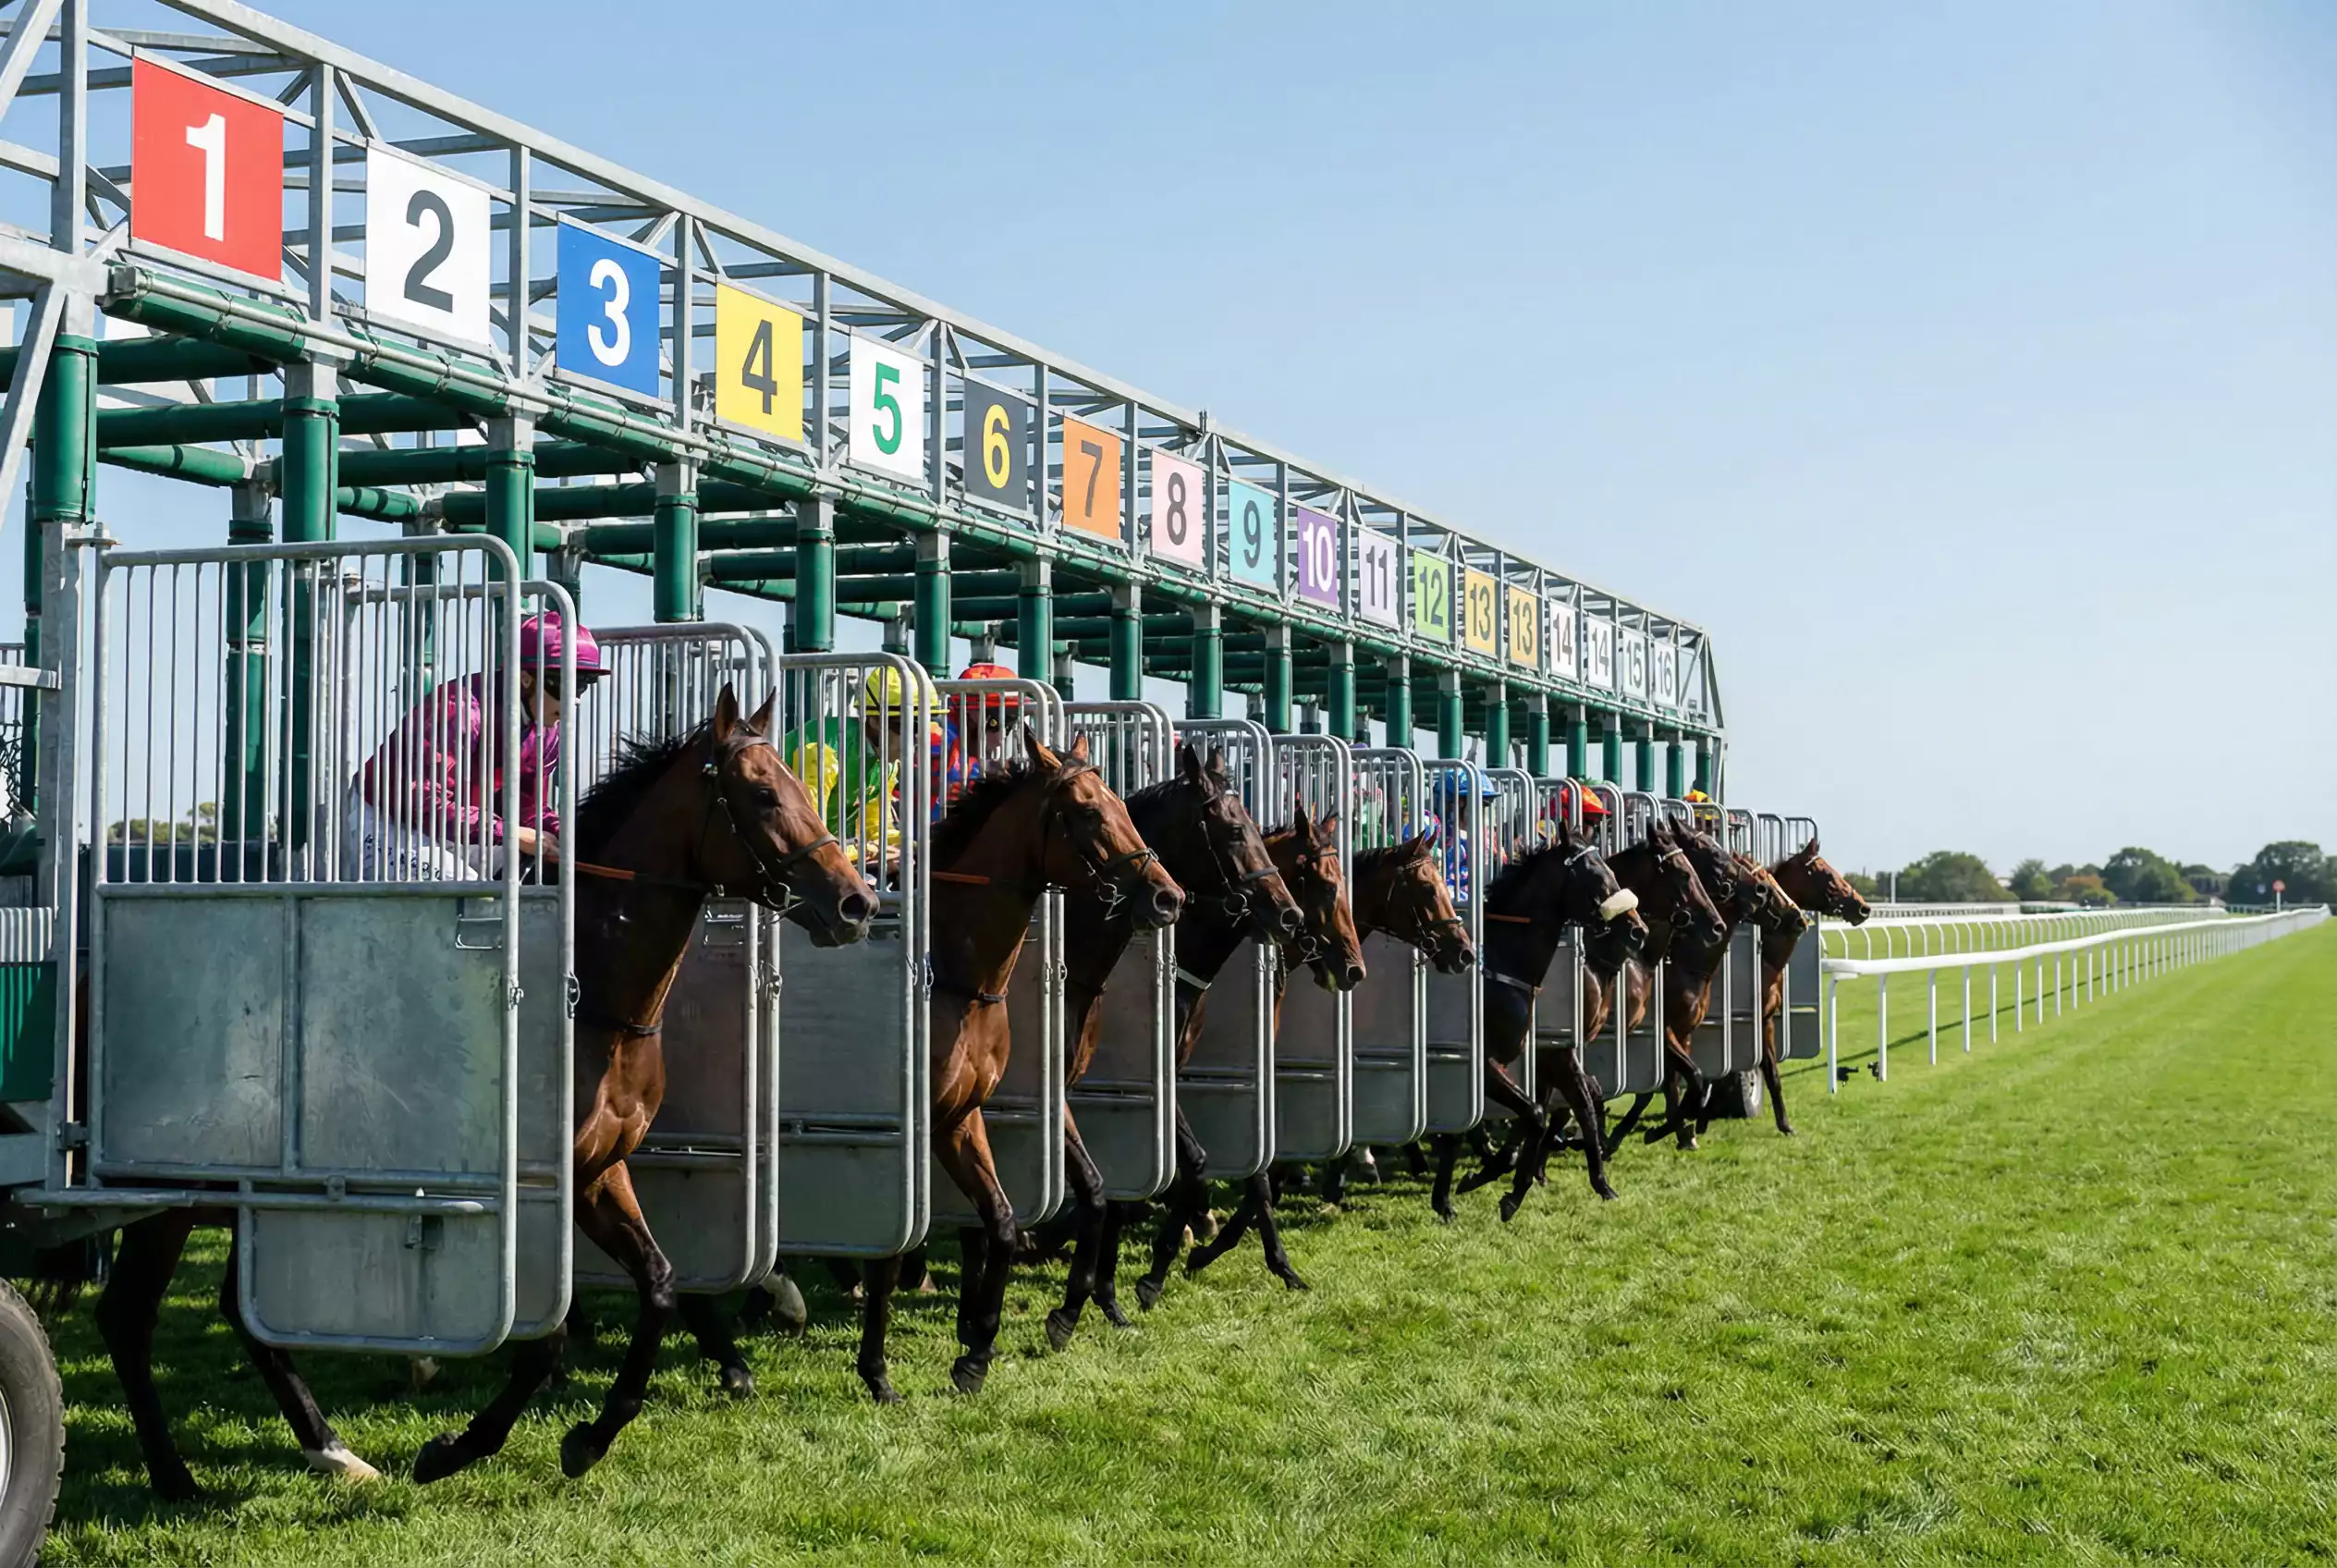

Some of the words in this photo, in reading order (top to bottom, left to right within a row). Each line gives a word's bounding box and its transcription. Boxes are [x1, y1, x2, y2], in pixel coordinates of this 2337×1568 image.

[186, 113, 225, 242] 1
[404, 190, 455, 312] 2
[586, 259, 630, 367] 3
[742, 319, 777, 415] 4
[873, 361, 902, 455] 5
[983, 404, 1010, 488] 6
[1081, 440, 1103, 517] 7
[1167, 472, 1187, 545] 8
[1243, 500, 1261, 569] 9
[1303, 521, 1334, 592] 10
[1365, 545, 1388, 610] 11
[1419, 566, 1444, 627] 12
[1470, 583, 1491, 641] 13
[1513, 598, 1533, 655] 13
[1553, 612, 1572, 666] 14
[1592, 627, 1609, 677] 14
[1626, 640, 1642, 689] 15
[1658, 650, 1672, 697] 16
